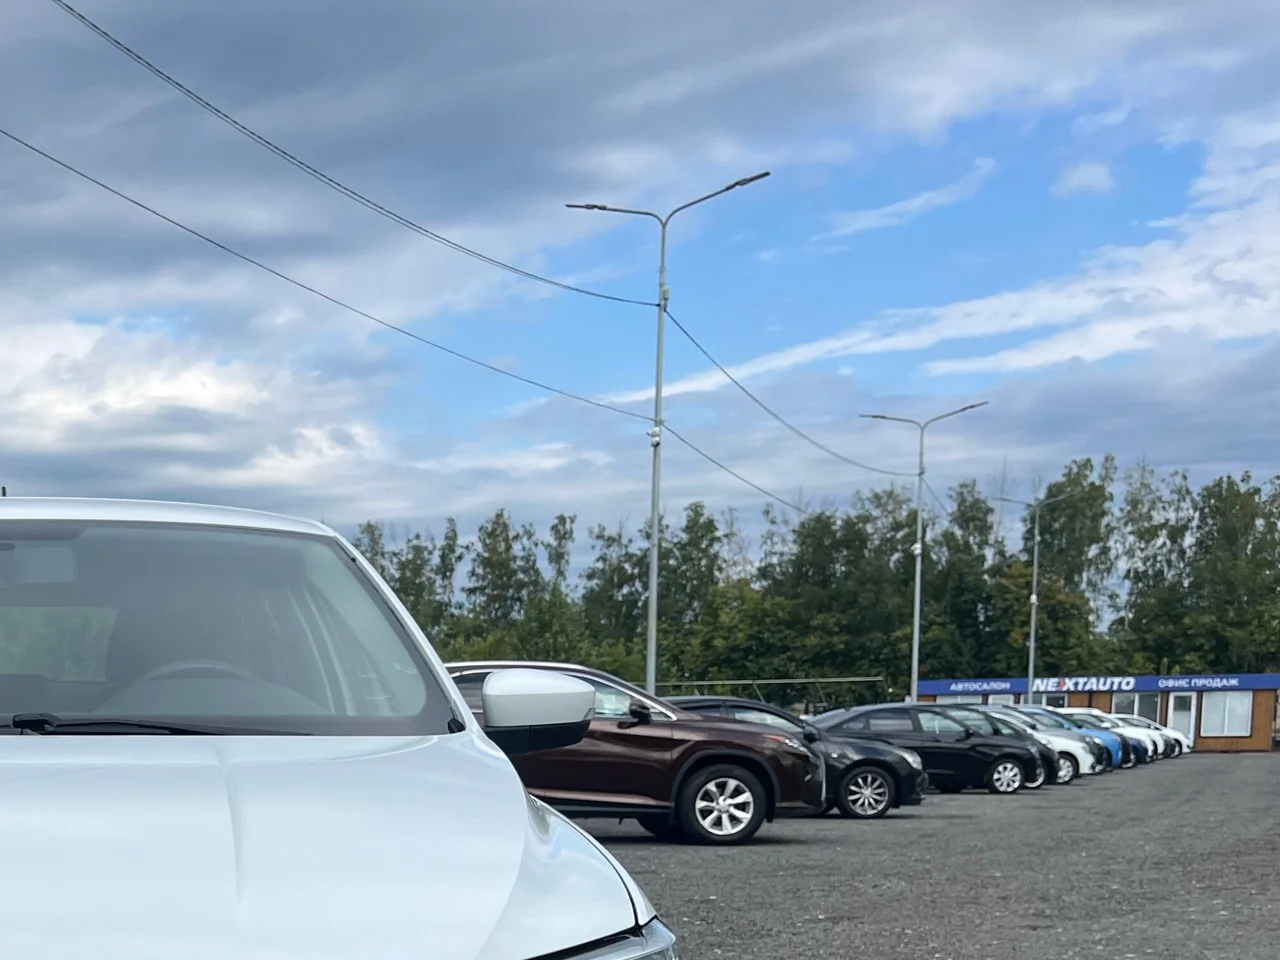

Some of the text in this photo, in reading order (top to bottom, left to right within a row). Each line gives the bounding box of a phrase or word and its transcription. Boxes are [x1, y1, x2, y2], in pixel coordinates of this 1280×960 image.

[949, 681, 1011, 691] АВТОСАЛОН
[1032, 677, 1135, 691] NEXTAUTO
[1158, 678, 1239, 688] ОФИС ПРОДАЖ
